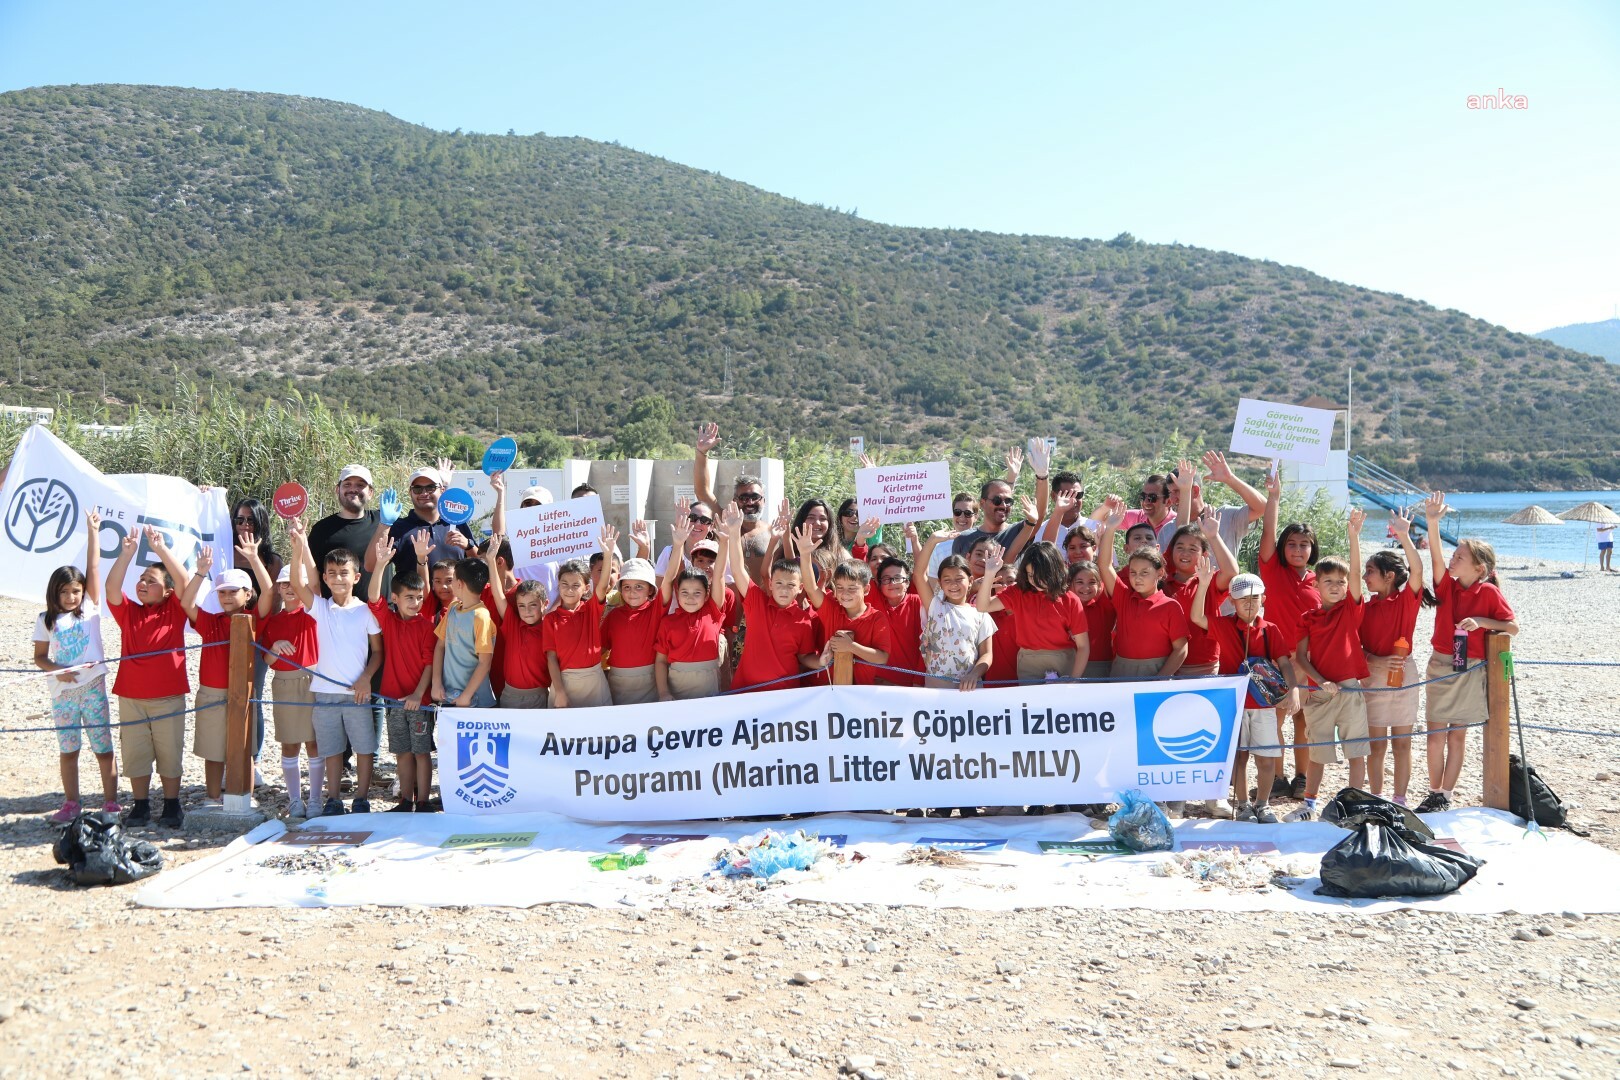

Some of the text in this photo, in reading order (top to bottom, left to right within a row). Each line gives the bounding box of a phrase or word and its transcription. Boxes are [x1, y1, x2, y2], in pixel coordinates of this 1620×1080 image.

[1266, 410, 1304, 423] Görevin
[1245, 416, 1320, 436] Sağlığı Koruma,
[1242, 426, 1321, 445] Hastalık Üretme
[1264, 439, 1295, 451] Değil!
[877, 470, 928, 483] Denizimizi
[883, 483, 924, 494] Kirletme
[863, 492, 946, 506] Mavi Bayrağımızı
[97, 505, 125, 520] THE
[538, 509, 571, 522] Lütfen,
[884, 504, 926, 515] İndirtme
[516, 516, 598, 539] Ayak İzlerinizden
[530, 530, 589, 548] BaşkaHatıra
[530, 541, 593, 560] Bırakmayınız
[456, 721, 511, 730] BODRUM
[539, 702, 1115, 760] Avrupa Çevre Ajansı Deniz Çöpleri İzleme
[574, 749, 1081, 801] Programı (Marina Litter Watch-MLV)
[1137, 771, 1187, 786] BLUE
[455, 786, 517, 809] BELEDİYESİ
[294, 833, 353, 841] METAL
[448, 835, 530, 844] ORGANİK
